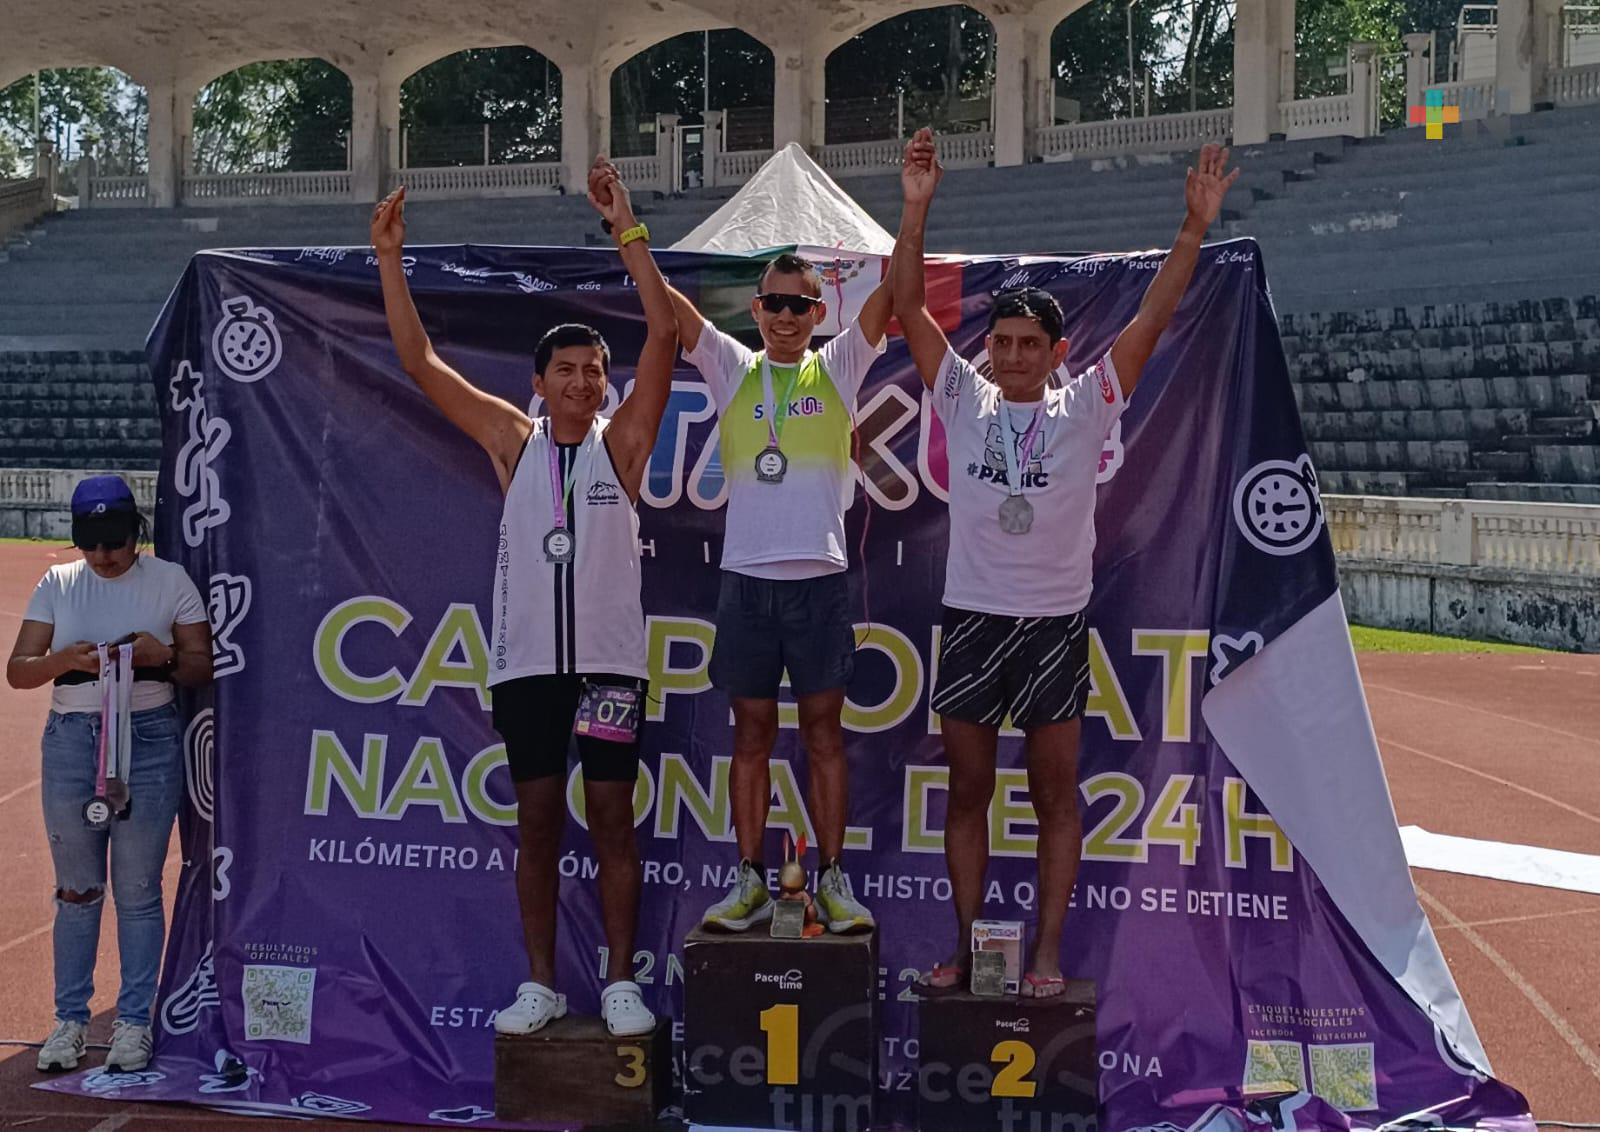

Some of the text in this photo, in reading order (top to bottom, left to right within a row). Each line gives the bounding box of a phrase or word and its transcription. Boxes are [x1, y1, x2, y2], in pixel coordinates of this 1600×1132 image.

[967, 461, 1049, 488] #PAIC
[597, 700, 632, 726] 07
[303, 729, 873, 851] NACONA
[308, 836, 479, 870] KILÓMETRO
[485, 848, 505, 871] A
[1086, 885, 1132, 910] NO
[1140, 887, 1178, 912] SE
[1186, 889, 1289, 920] DETIENE
[244, 943, 318, 955] RESULTADOS
[250, 952, 309, 964] OFICIALES
[754, 972, 785, 984] Pacer
[779, 980, 803, 990] time
[430, 1006, 498, 1028] ESTA
[1248, 1004, 1365, 1018] ETIQUETA NUESTRAS
[1262, 1014, 1296, 1025] REDES
[759, 1003, 799, 1085] 1
[1312, 1032, 1367, 1042] INSTAGRAM
[614, 1046, 647, 1088] 3
[990, 1039, 1037, 1098] 2
